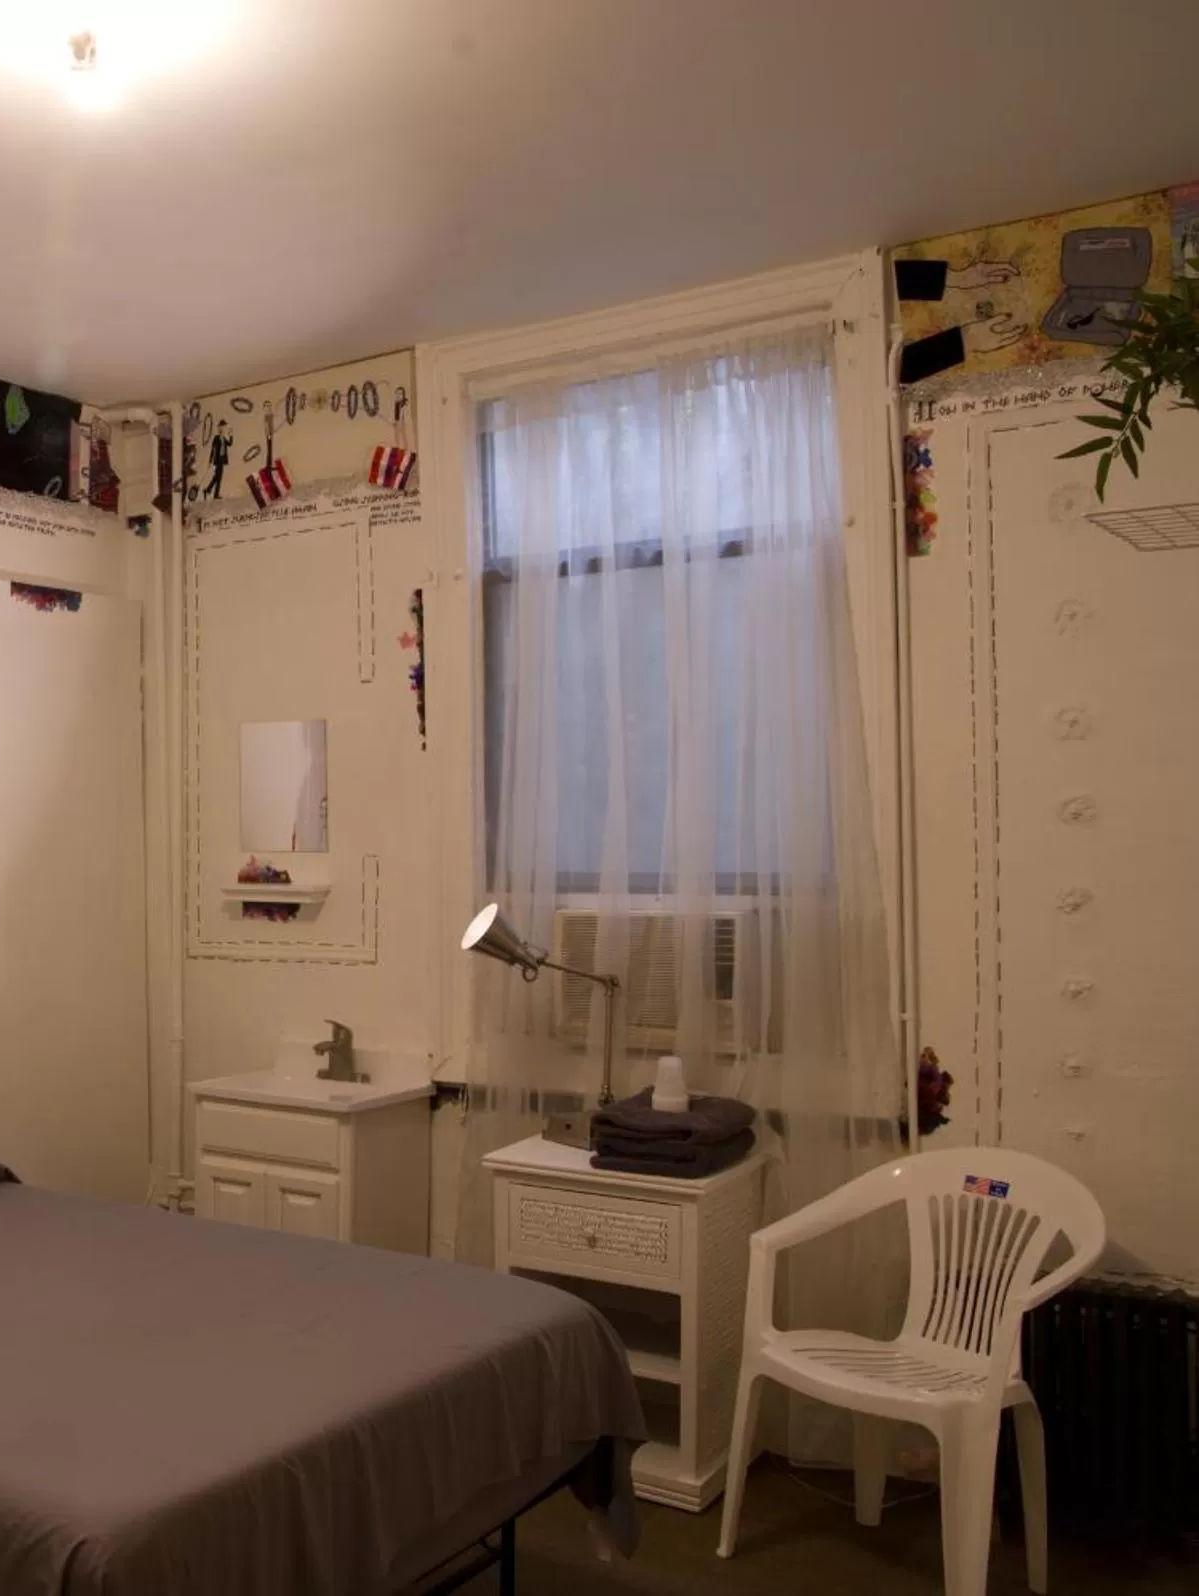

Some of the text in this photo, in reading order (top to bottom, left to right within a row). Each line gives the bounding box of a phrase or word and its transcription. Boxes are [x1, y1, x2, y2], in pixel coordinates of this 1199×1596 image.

[962, 401, 976, 413] IN
[981, 394, 1010, 410] THE
[1058, 385, 1076, 398] OF
